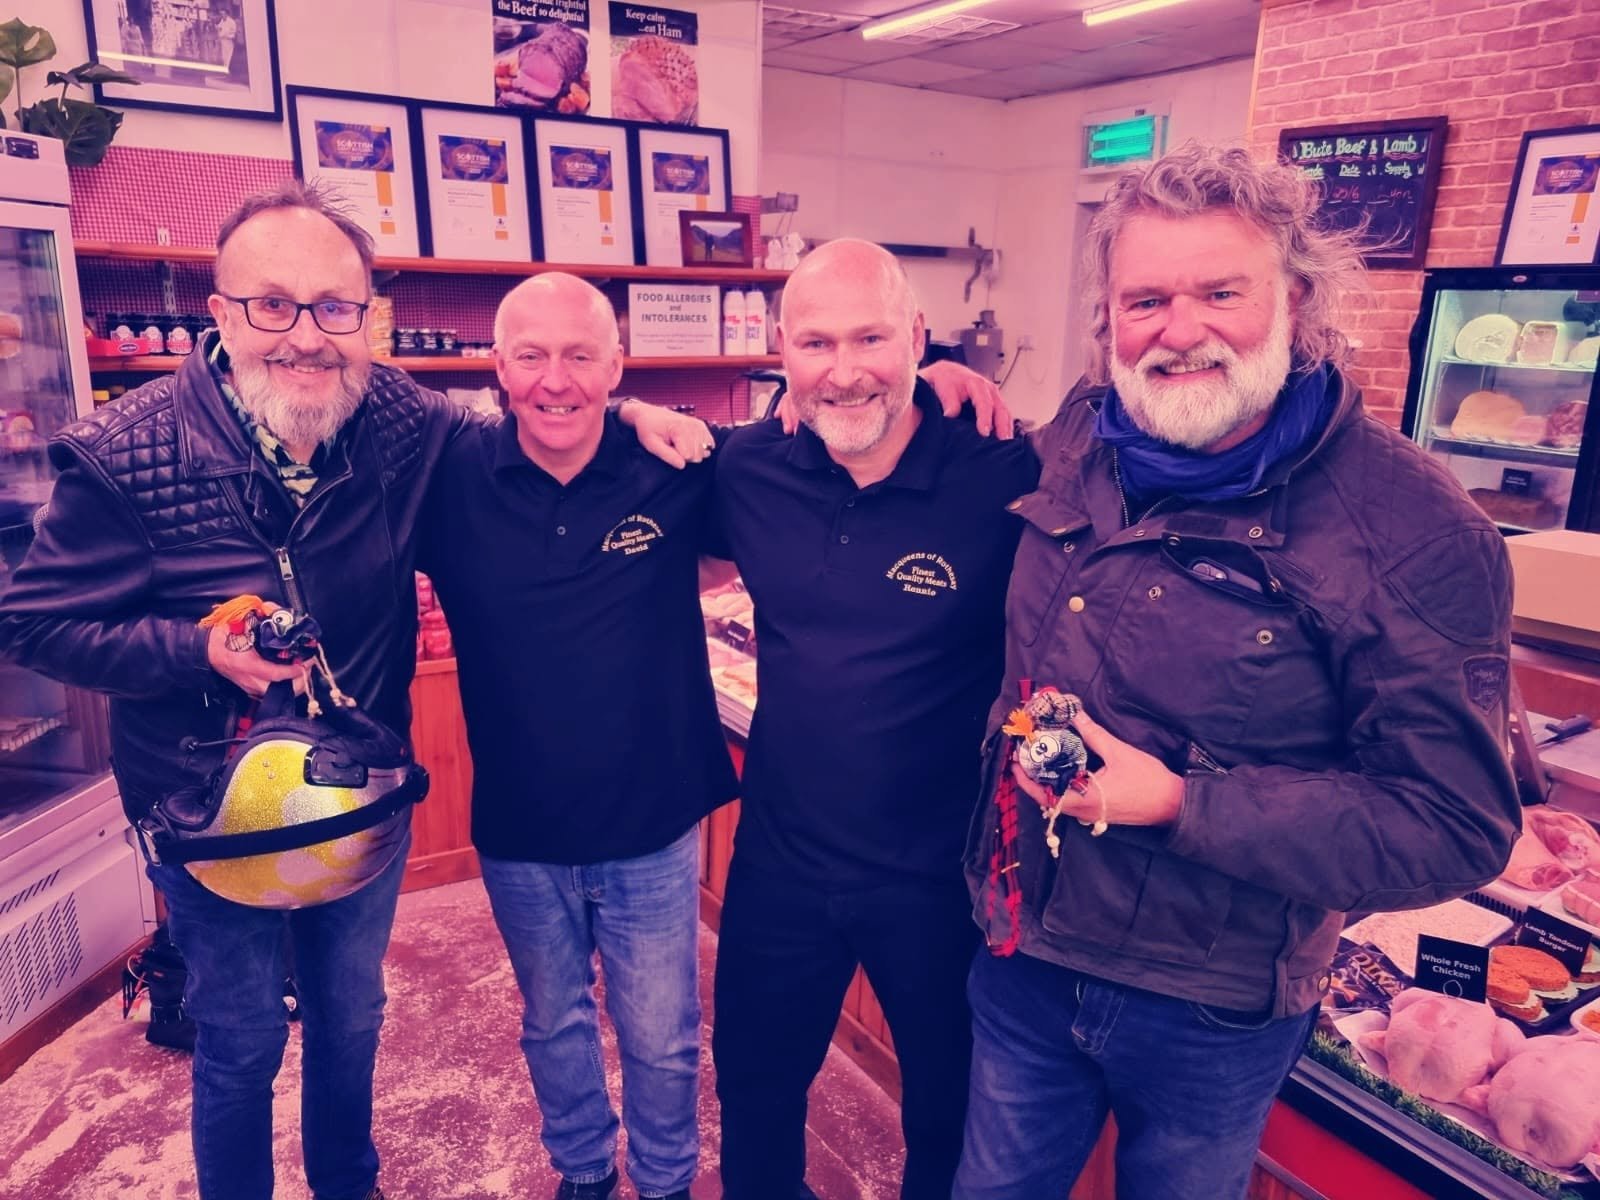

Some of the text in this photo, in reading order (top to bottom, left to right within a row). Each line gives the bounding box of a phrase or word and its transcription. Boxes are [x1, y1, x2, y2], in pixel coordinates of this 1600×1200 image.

[498, 0, 585, 23] the Beef so delightful
[625, 8, 667, 23] Keep calm
[657, 25, 683, 39] Ham
[1335, 137, 1367, 156] Beef
[1383, 134, 1417, 154] Lamb
[636, 292, 712, 304] FOOD ALLERGIES
[669, 304, 682, 312] and
[641, 314, 708, 323] INTOLERANCES
[624, 543, 649, 555] David
[885, 552, 958, 590] Macqueens of Rothesay
[911, 566, 936, 578] Finest
[896, 571, 948, 588] Quality Meats
[1524, 922, 1546, 937] Lamb
[1537, 936, 1567, 953] Burger
[1420, 952, 1482, 973] Whole Fresh
[1431, 964, 1471, 981] Chicken
